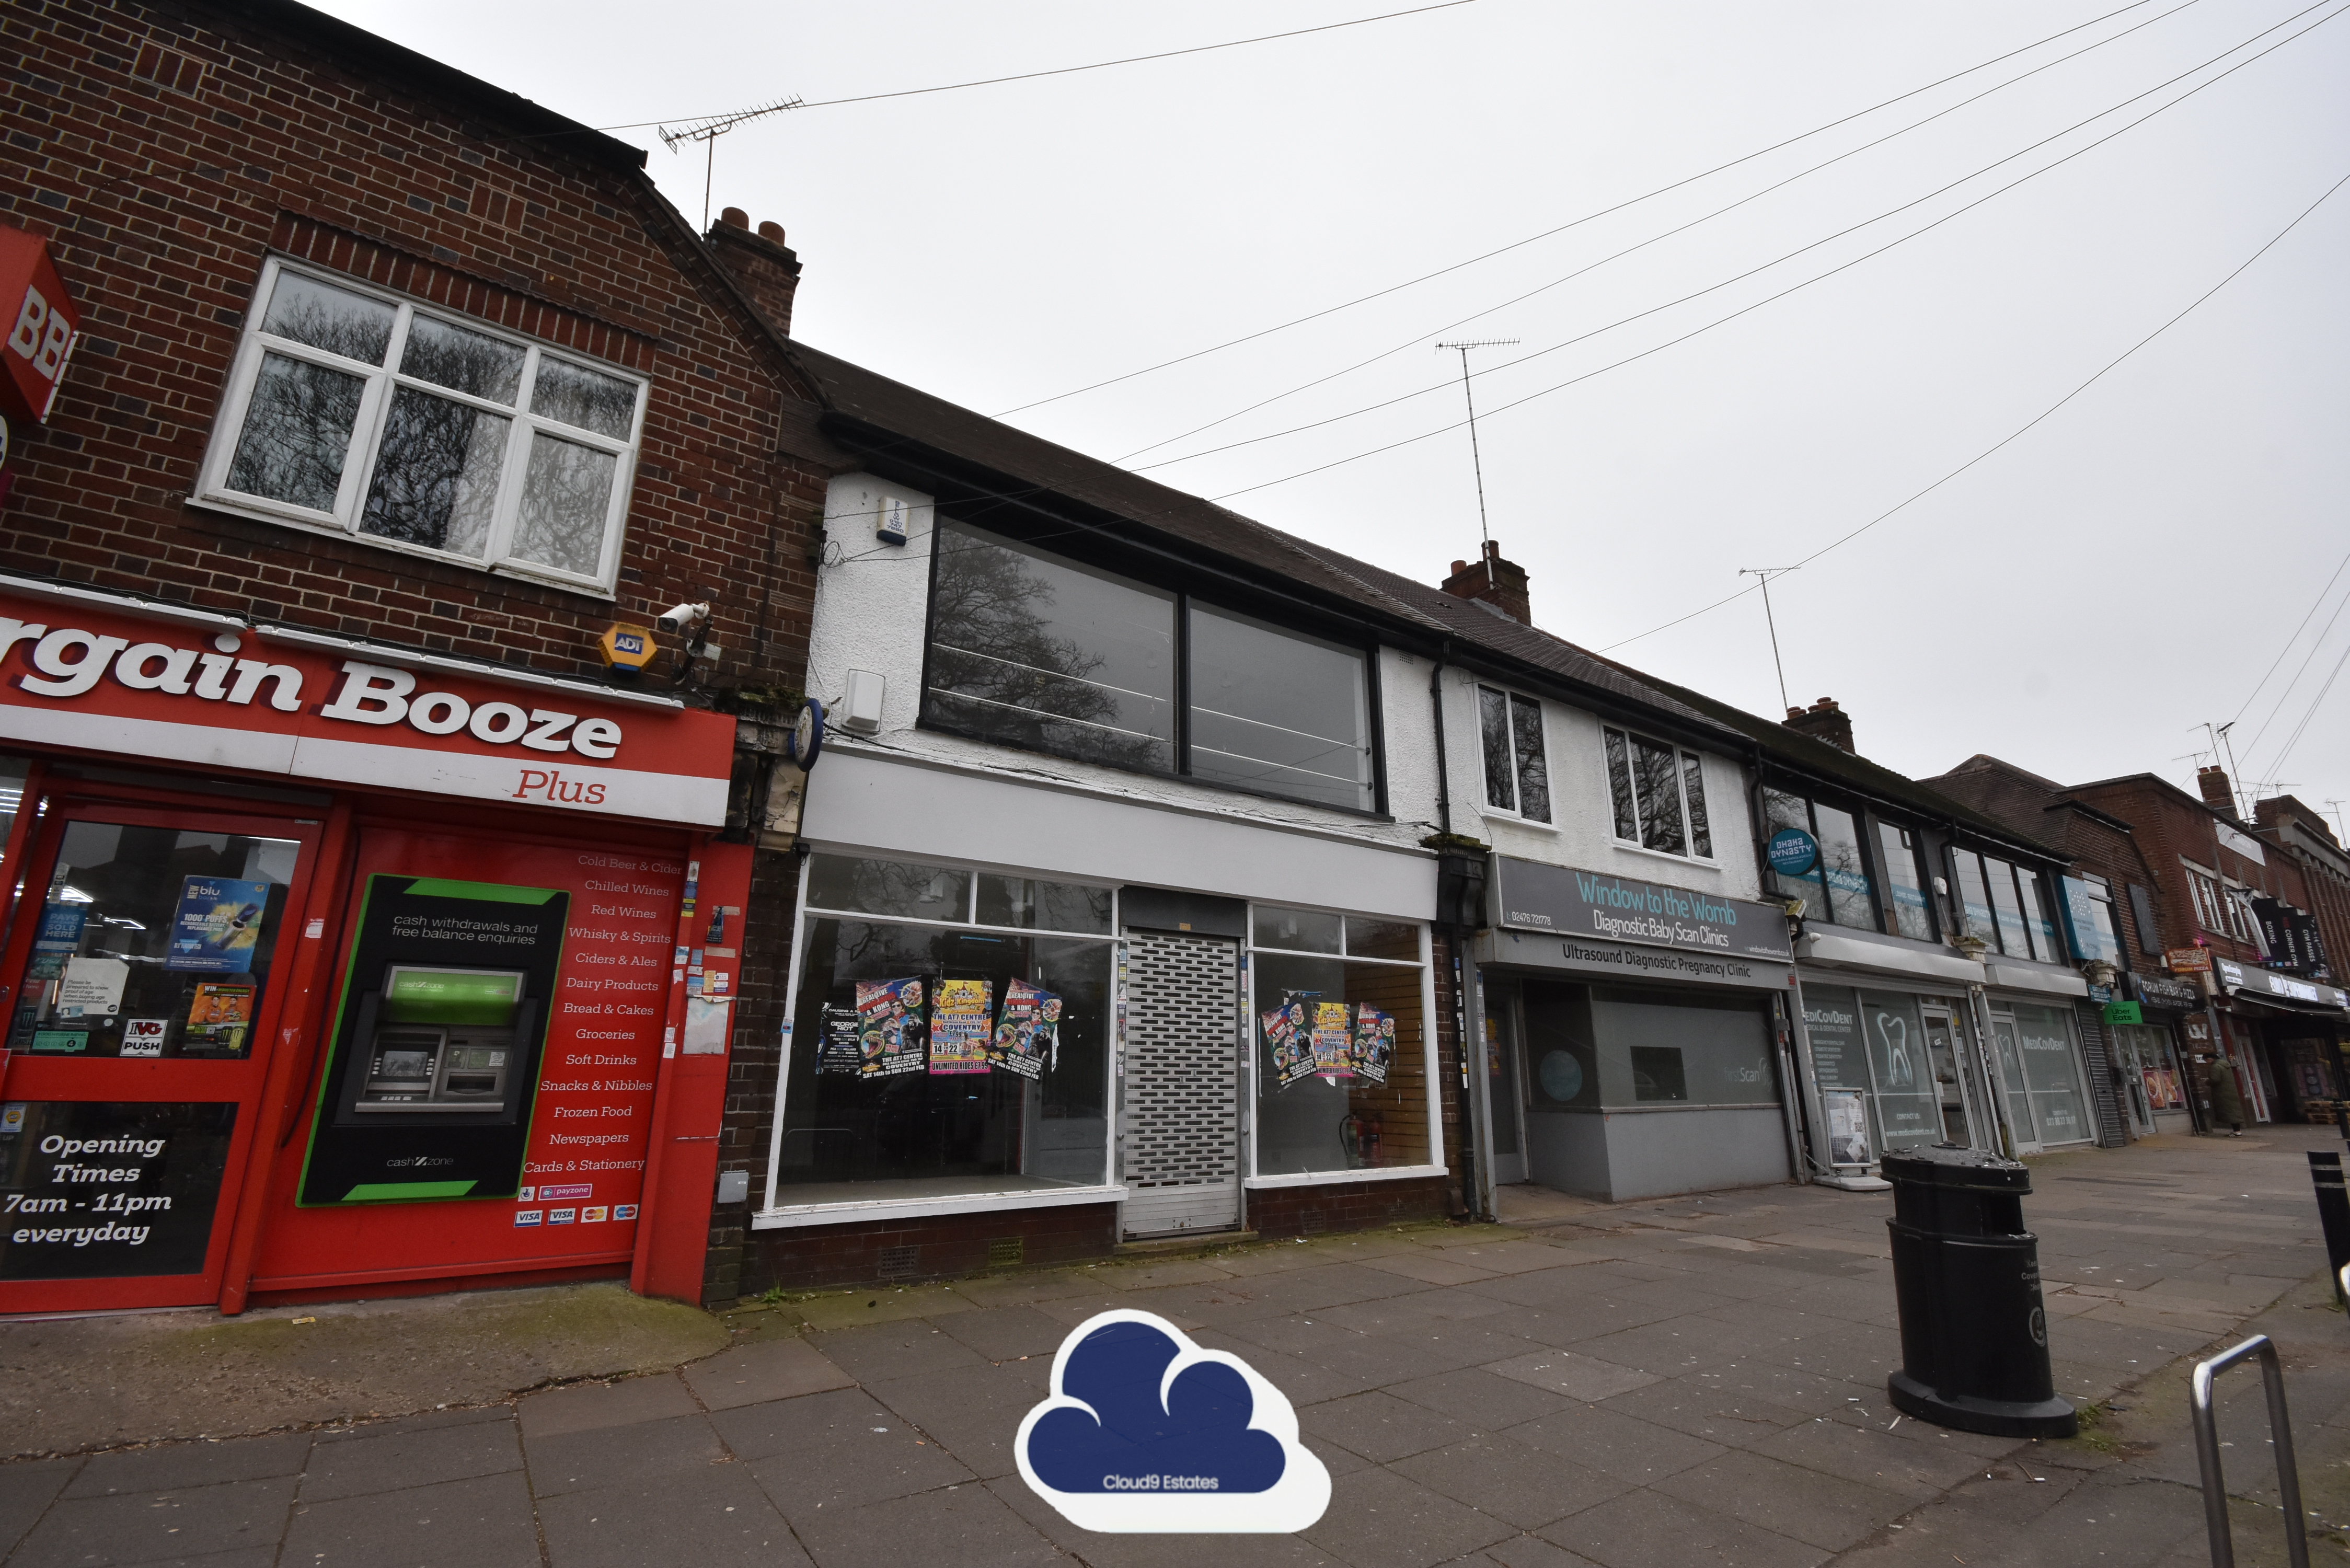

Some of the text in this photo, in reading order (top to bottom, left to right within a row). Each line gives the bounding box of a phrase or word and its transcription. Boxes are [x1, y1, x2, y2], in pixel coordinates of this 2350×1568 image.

[7, 284, 71, 381] BB
[615, 635, 643, 654] ADT
[320, 661, 622, 758] Booze
[512, 769, 607, 805] Plus
[578, 856, 682, 874] Cold Beer & Cider
[200, 886, 220, 895] blu
[585, 880, 669, 896] Chilled Wines
[1576, 872, 1736, 926] Window to the Womb
[591, 905, 656, 918] Red Wines
[1512, 912, 1551, 925] 02476 721778
[205, 915, 229, 924] PUFFS,
[394, 916, 538, 933] cash withdrawals and
[1593, 909, 1729, 947] Diagnostic Baby Scan Clinics
[2265, 921, 2277, 944] BOXING
[392, 926, 536, 945] free balance enquiries
[569, 927, 671, 944] Whisky & Spirits
[2285, 929, 2296, 953] CORNER
[2302, 929, 2316, 962] GYM PASSES
[575, 953, 657, 966] Ciders & Ales
[1562, 943, 1751, 978] Ultrasound Diagnostic Pregnancy Clinic
[566, 977, 659, 991] Dairy Products
[2141, 980, 2159, 993] FORUM
[563, 1003, 654, 1015] Bread & Cakes
[872, 1001, 890, 1013] KONG
[939, 997, 985, 1008] Kidz Kingdom
[129, 1022, 163, 1035] IVG
[575, 1029, 635, 1040] Groceries
[124, 1042, 160, 1050] PUSH
[566, 1054, 637, 1065] Soft Drinks
[885, 1061, 920, 1069] COVENTRY
[932, 1062, 958, 1070] UNLIMITED
[974, 1061, 988, 1069] £7.99
[1025, 1058, 1042, 1068] CENTRE
[1008, 1060, 1038, 1074] COVENTRY
[540, 1080, 652, 1091] Snacks & Nibbles
[554, 1105, 632, 1117] Frozen Food
[40, 1134, 166, 1158] Opening
[549, 1134, 629, 1146] Newspapers
[52, 1163, 141, 1183] Times
[523, 1159, 646, 1173] Cards & Stationery
[556, 1186, 589, 1196] payzone
[4, 1193, 172, 1216] 7am 11pm
[519, 1212, 540, 1221] VISA
[12, 1221, 151, 1247] everyday
